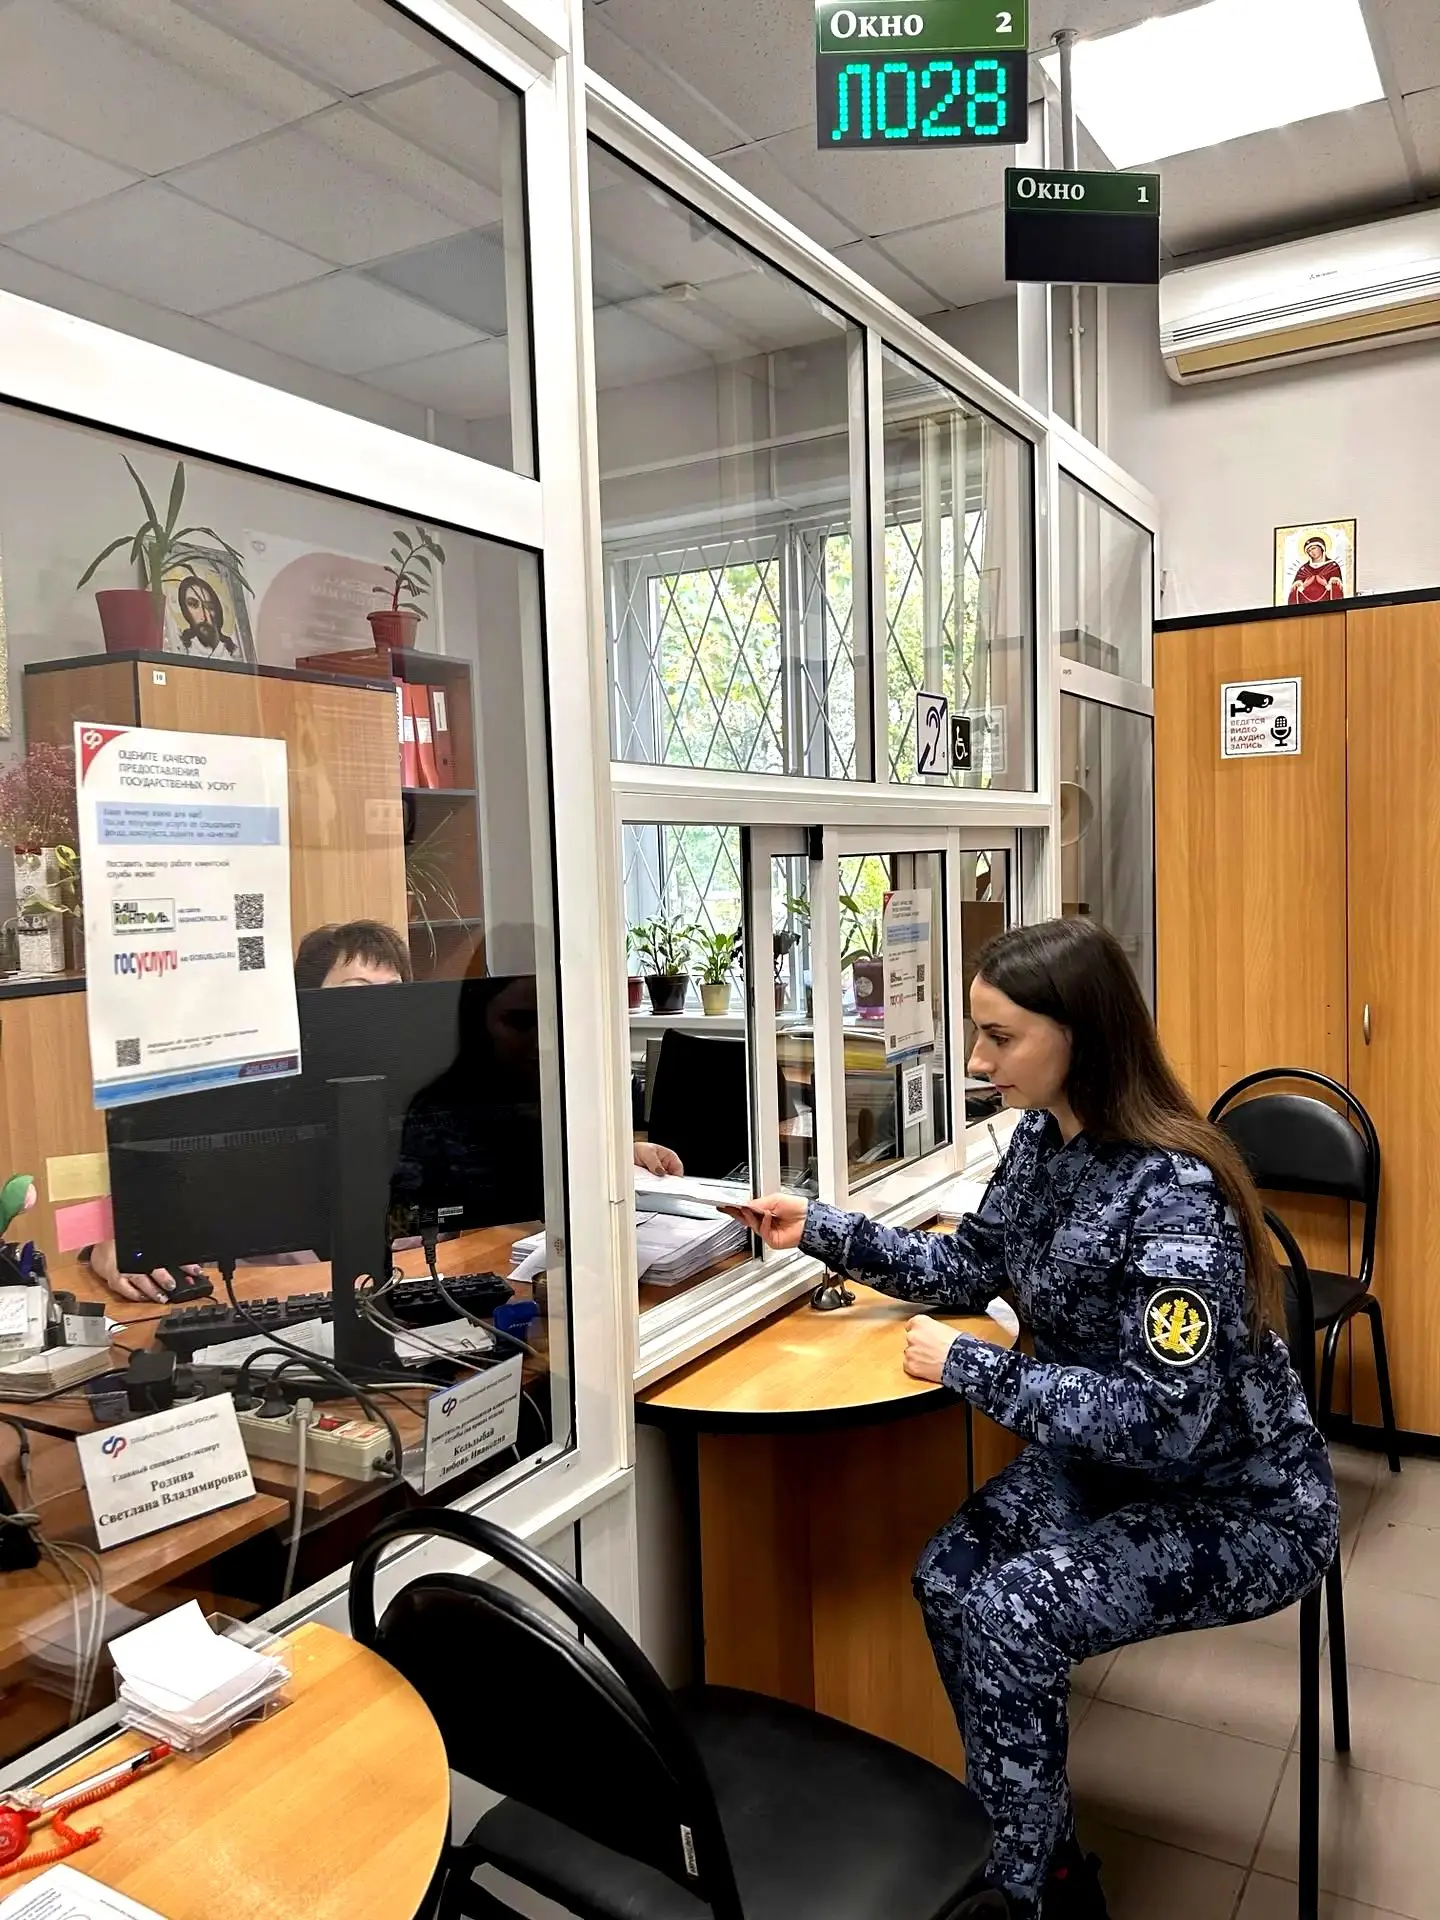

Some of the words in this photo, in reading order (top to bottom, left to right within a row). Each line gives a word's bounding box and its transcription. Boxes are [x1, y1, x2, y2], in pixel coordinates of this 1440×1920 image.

[995, 12, 1013, 33] 2
[1137, 187, 1149, 203] 1
[1231, 718, 1265, 726] ВЕДЕТСЯ
[1237, 734, 1266, 742] АУДИО
[118, 750, 158, 762] ОЦЕНИТЕ
[162, 753, 207, 765] КАЧЕСТВО
[119, 764, 200, 776] ПРЕДОСТАВЛЕНИЯ
[120, 777, 203, 790] ГОСУДАРСТВЕННЫХ
[207, 782, 236, 791] УСЛУГ
[114, 902, 138, 913] ВАШ
[112, 1466, 148, 1483] Главный
[149, 1443, 220, 1471] специалист-эксперт
[151, 1471, 195, 1492] Родина
[99, 1499, 160, 1527] Светлана
[161, 1469, 249, 1506] Владимировна
